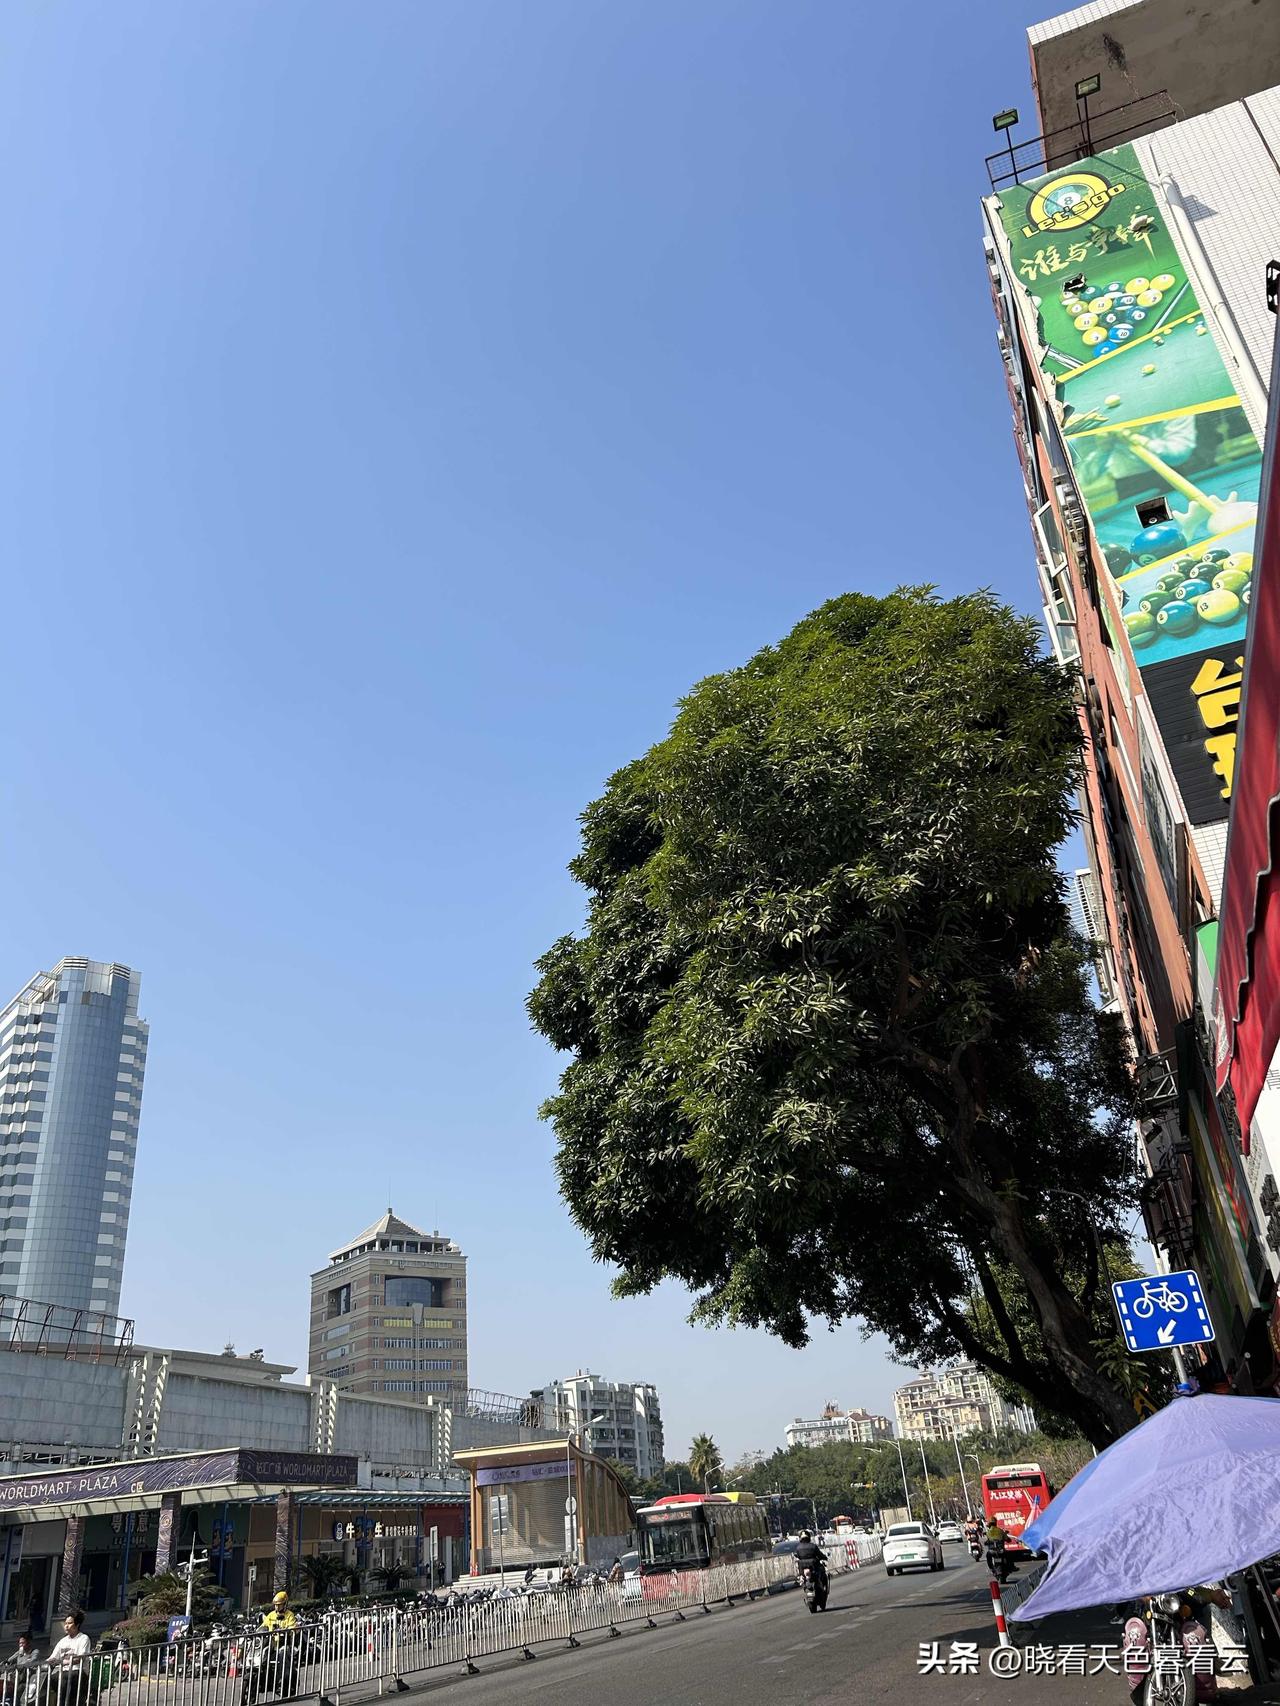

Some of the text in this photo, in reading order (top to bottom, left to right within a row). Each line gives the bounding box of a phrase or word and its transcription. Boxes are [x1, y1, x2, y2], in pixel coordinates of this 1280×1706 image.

[283, 1462, 348, 1477] WORLDMART PLAZA
[0, 1480, 72, 1501] WORLDMART
[79, 1475, 118, 1492] PLAZA
